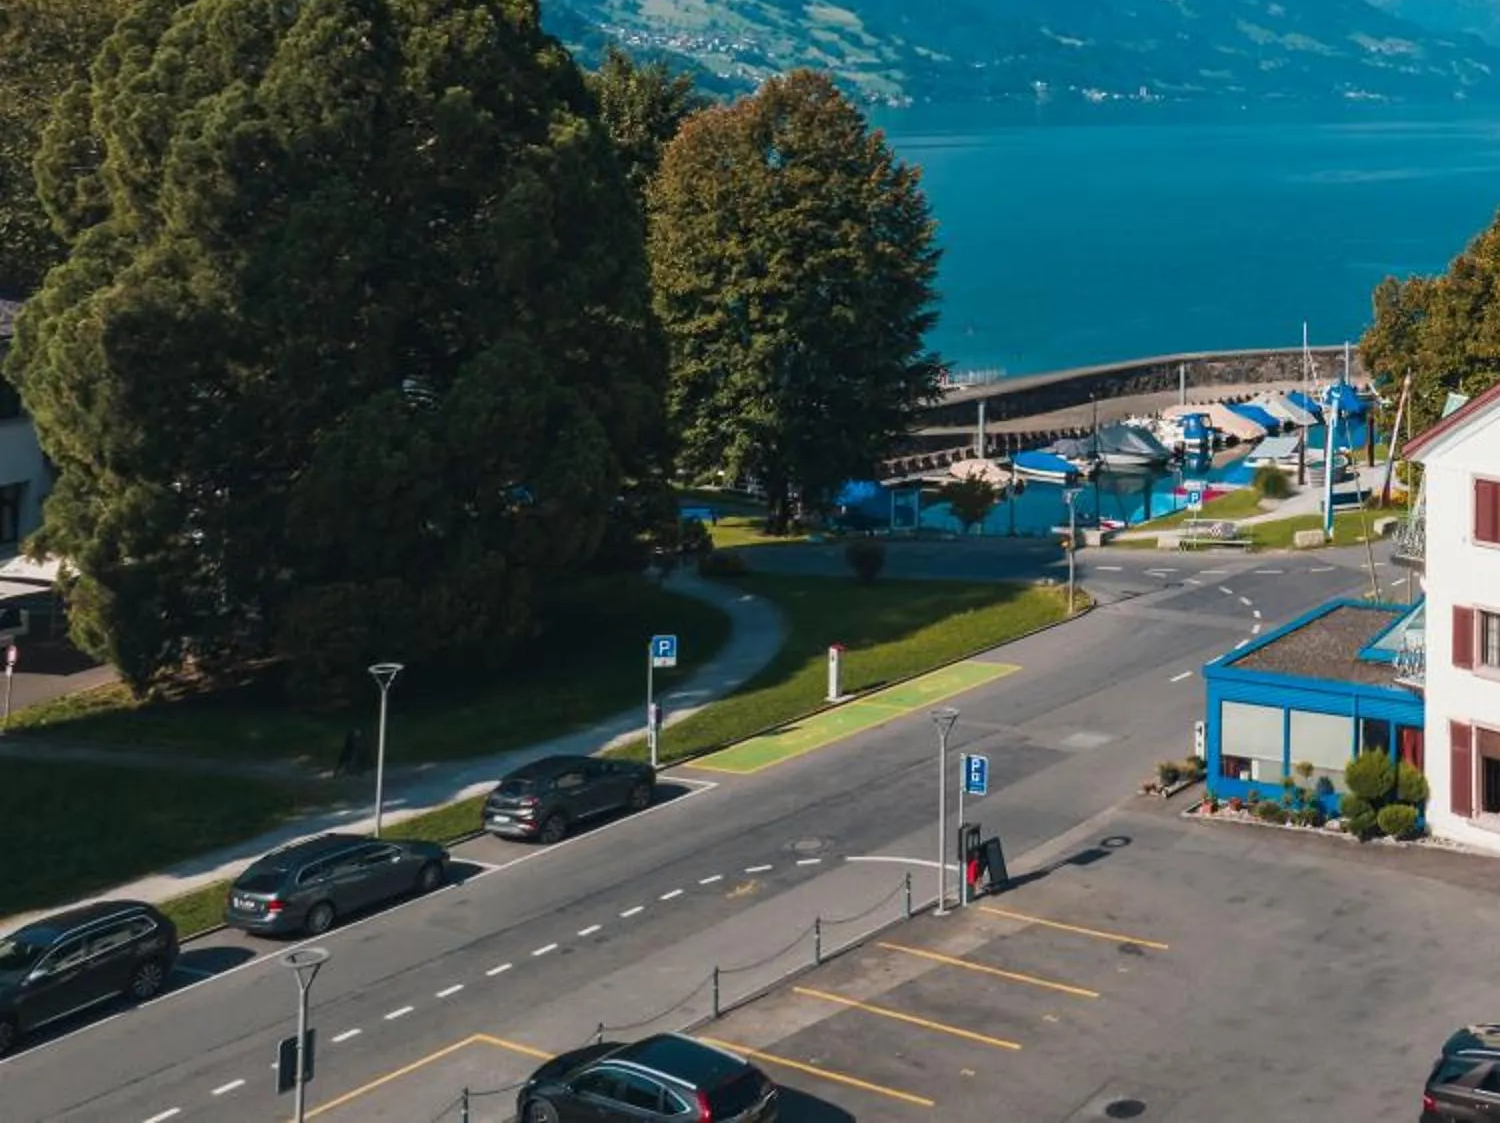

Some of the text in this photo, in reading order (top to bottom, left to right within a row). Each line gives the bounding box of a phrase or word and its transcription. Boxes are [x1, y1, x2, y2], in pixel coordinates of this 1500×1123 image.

[1191, 492, 1199, 503] P
[660, 641, 670, 655] P
[972, 759, 980, 772] P
